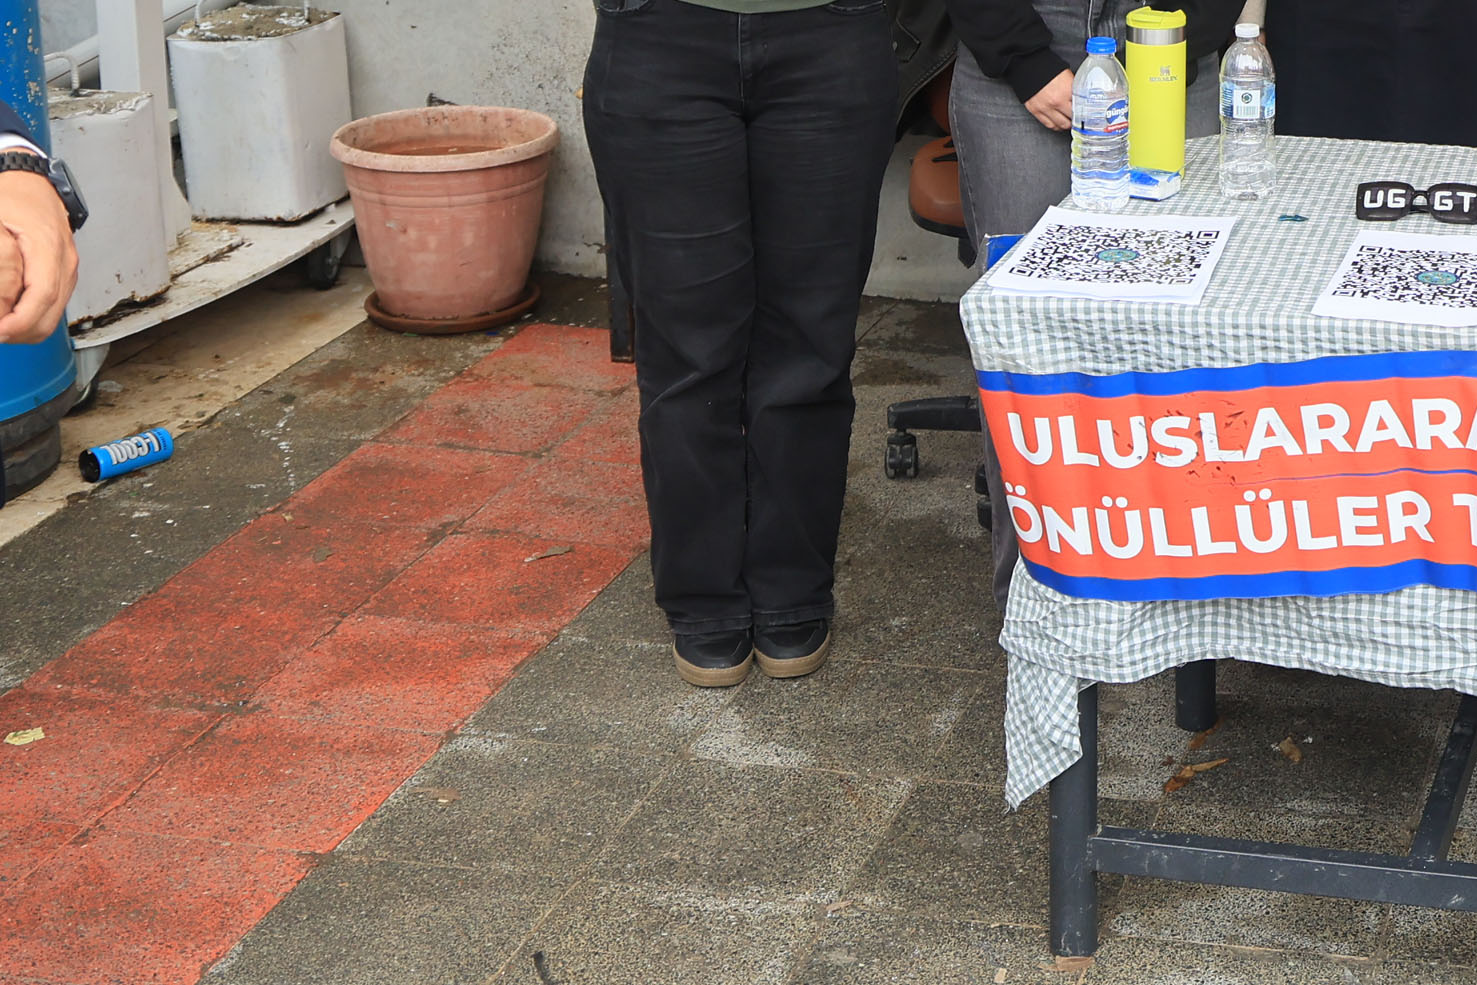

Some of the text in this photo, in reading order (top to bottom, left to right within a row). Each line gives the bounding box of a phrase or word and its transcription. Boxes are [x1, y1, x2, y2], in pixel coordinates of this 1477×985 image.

[1363, 188, 1477, 213] UG GT
[1004, 480, 1436, 559] ÖNÜLLÜLER
